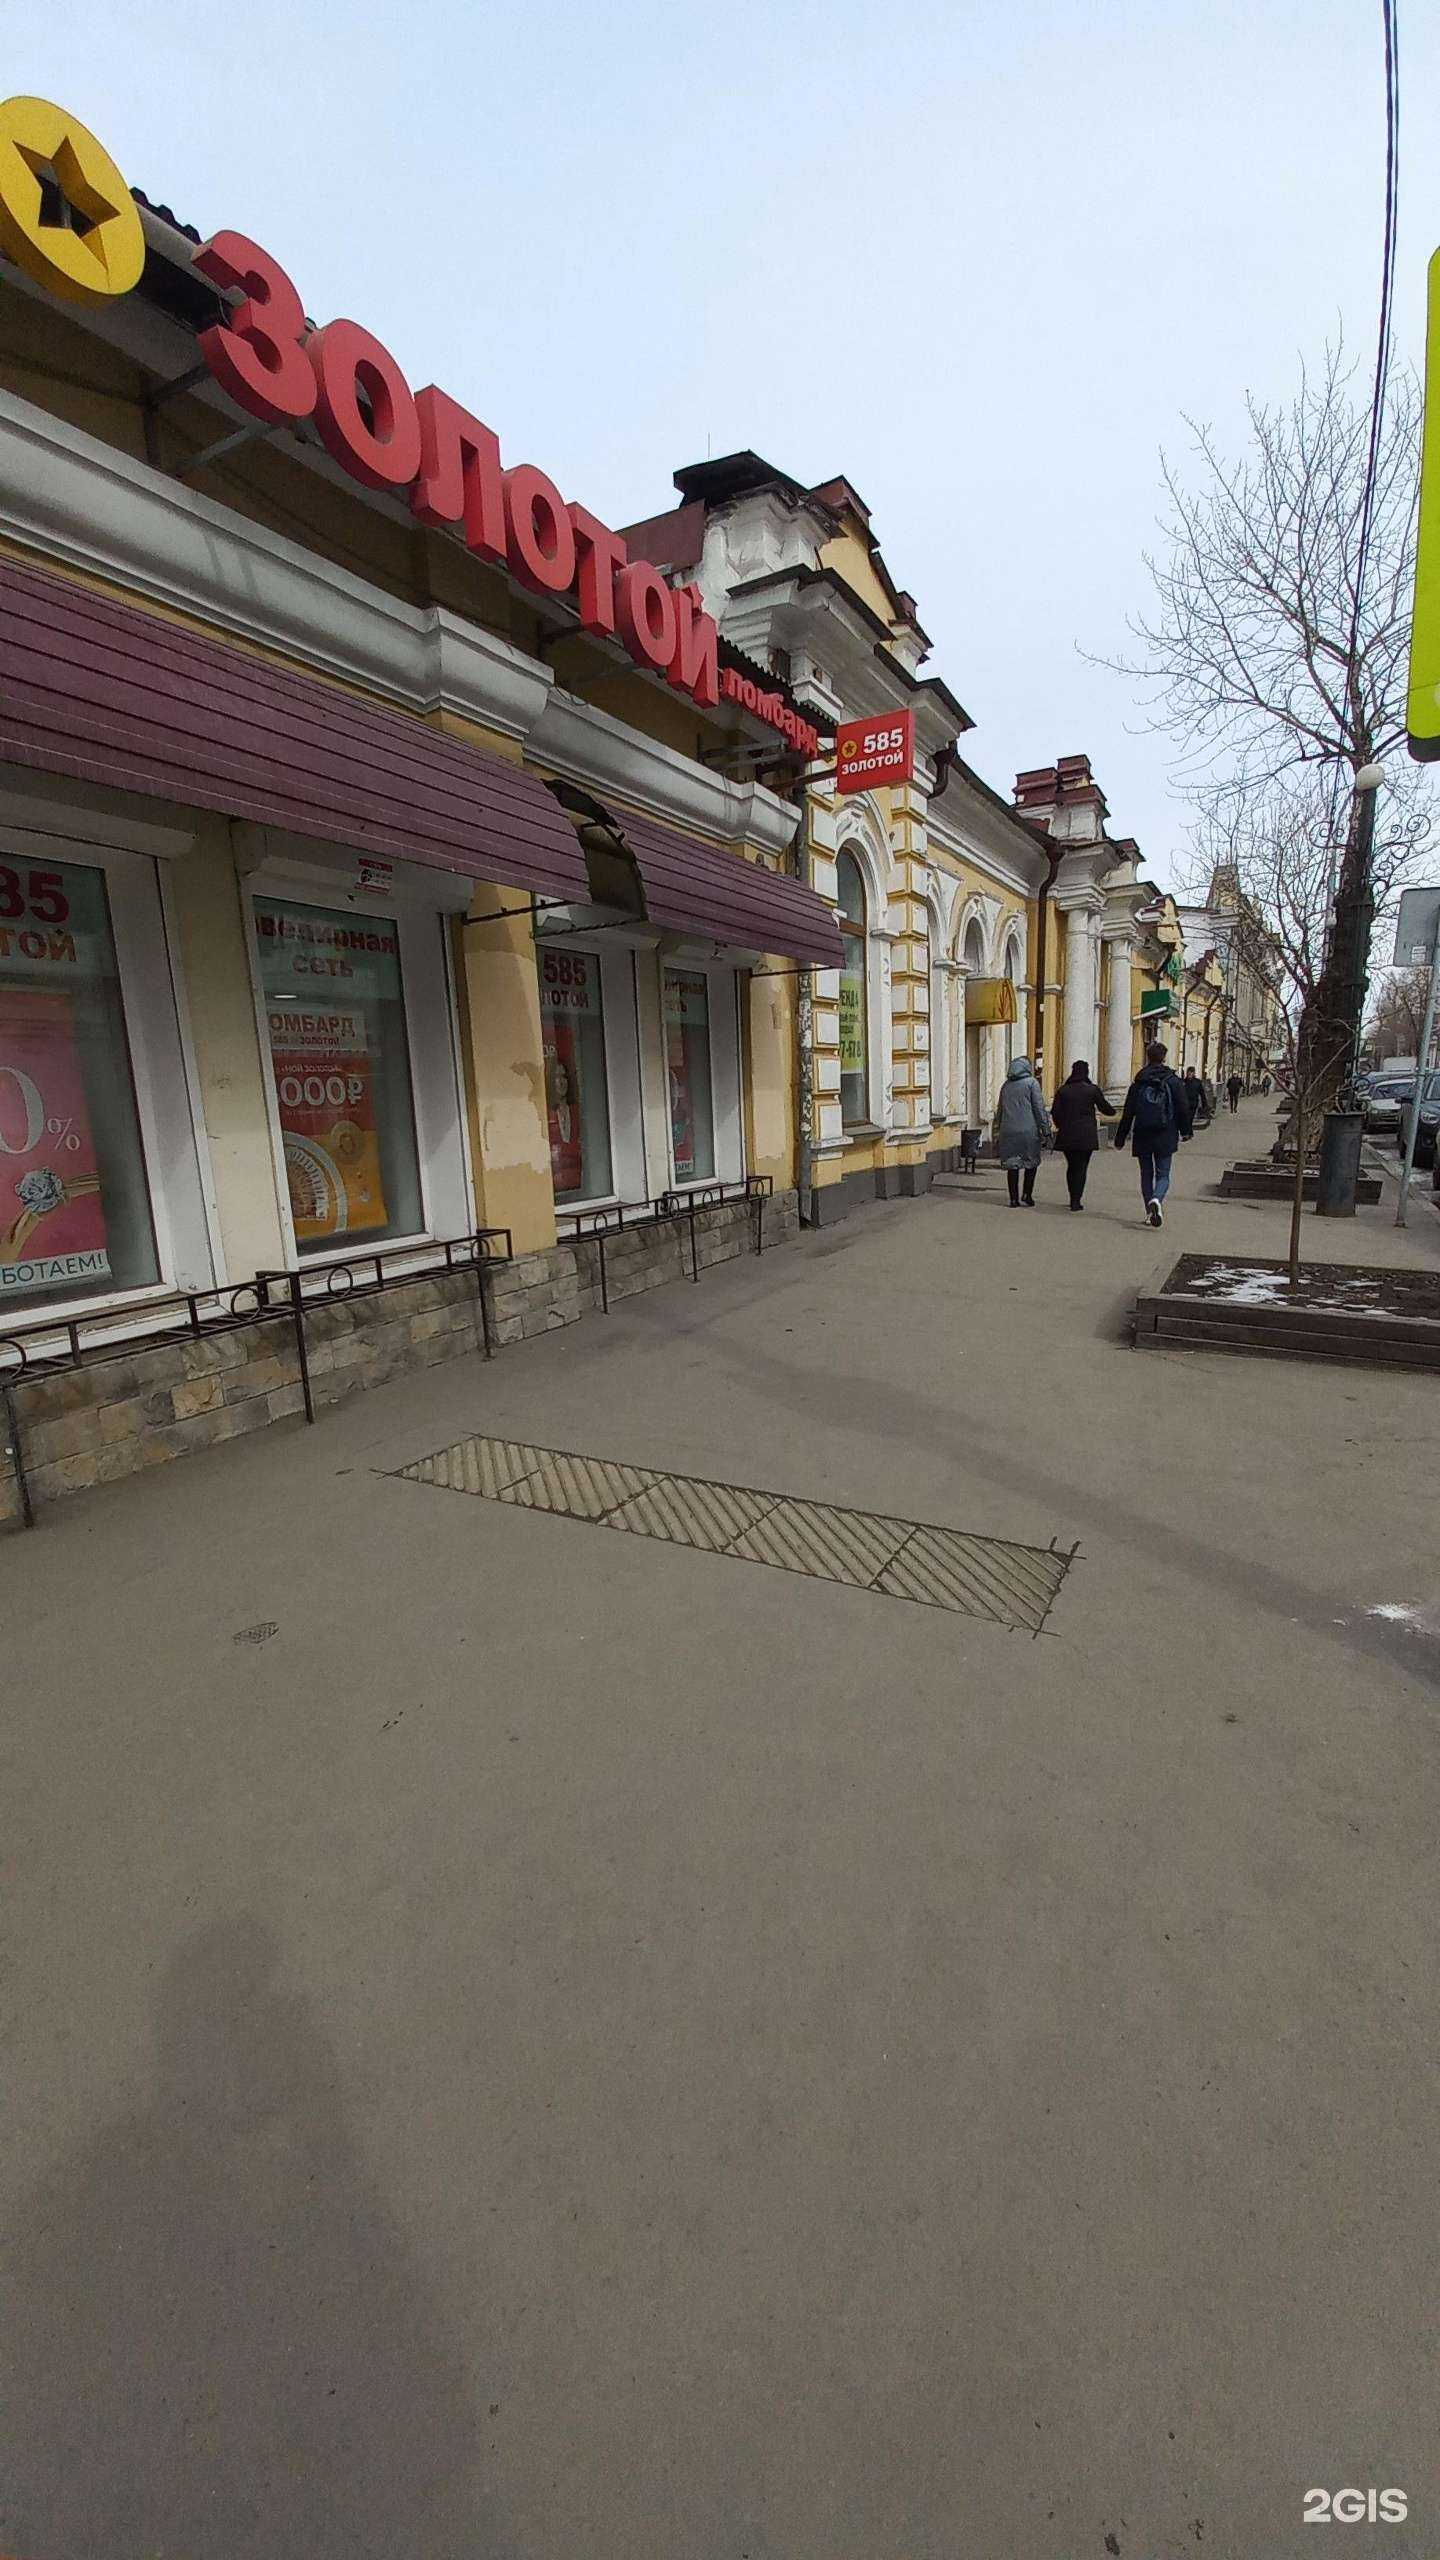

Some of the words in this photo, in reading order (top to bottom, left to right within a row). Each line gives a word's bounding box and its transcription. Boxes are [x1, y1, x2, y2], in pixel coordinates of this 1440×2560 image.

[863, 727, 904, 753] 585
[543, 953, 587, 987] 585
[2, 1253, 104, 1285] БОТАЕМ!
